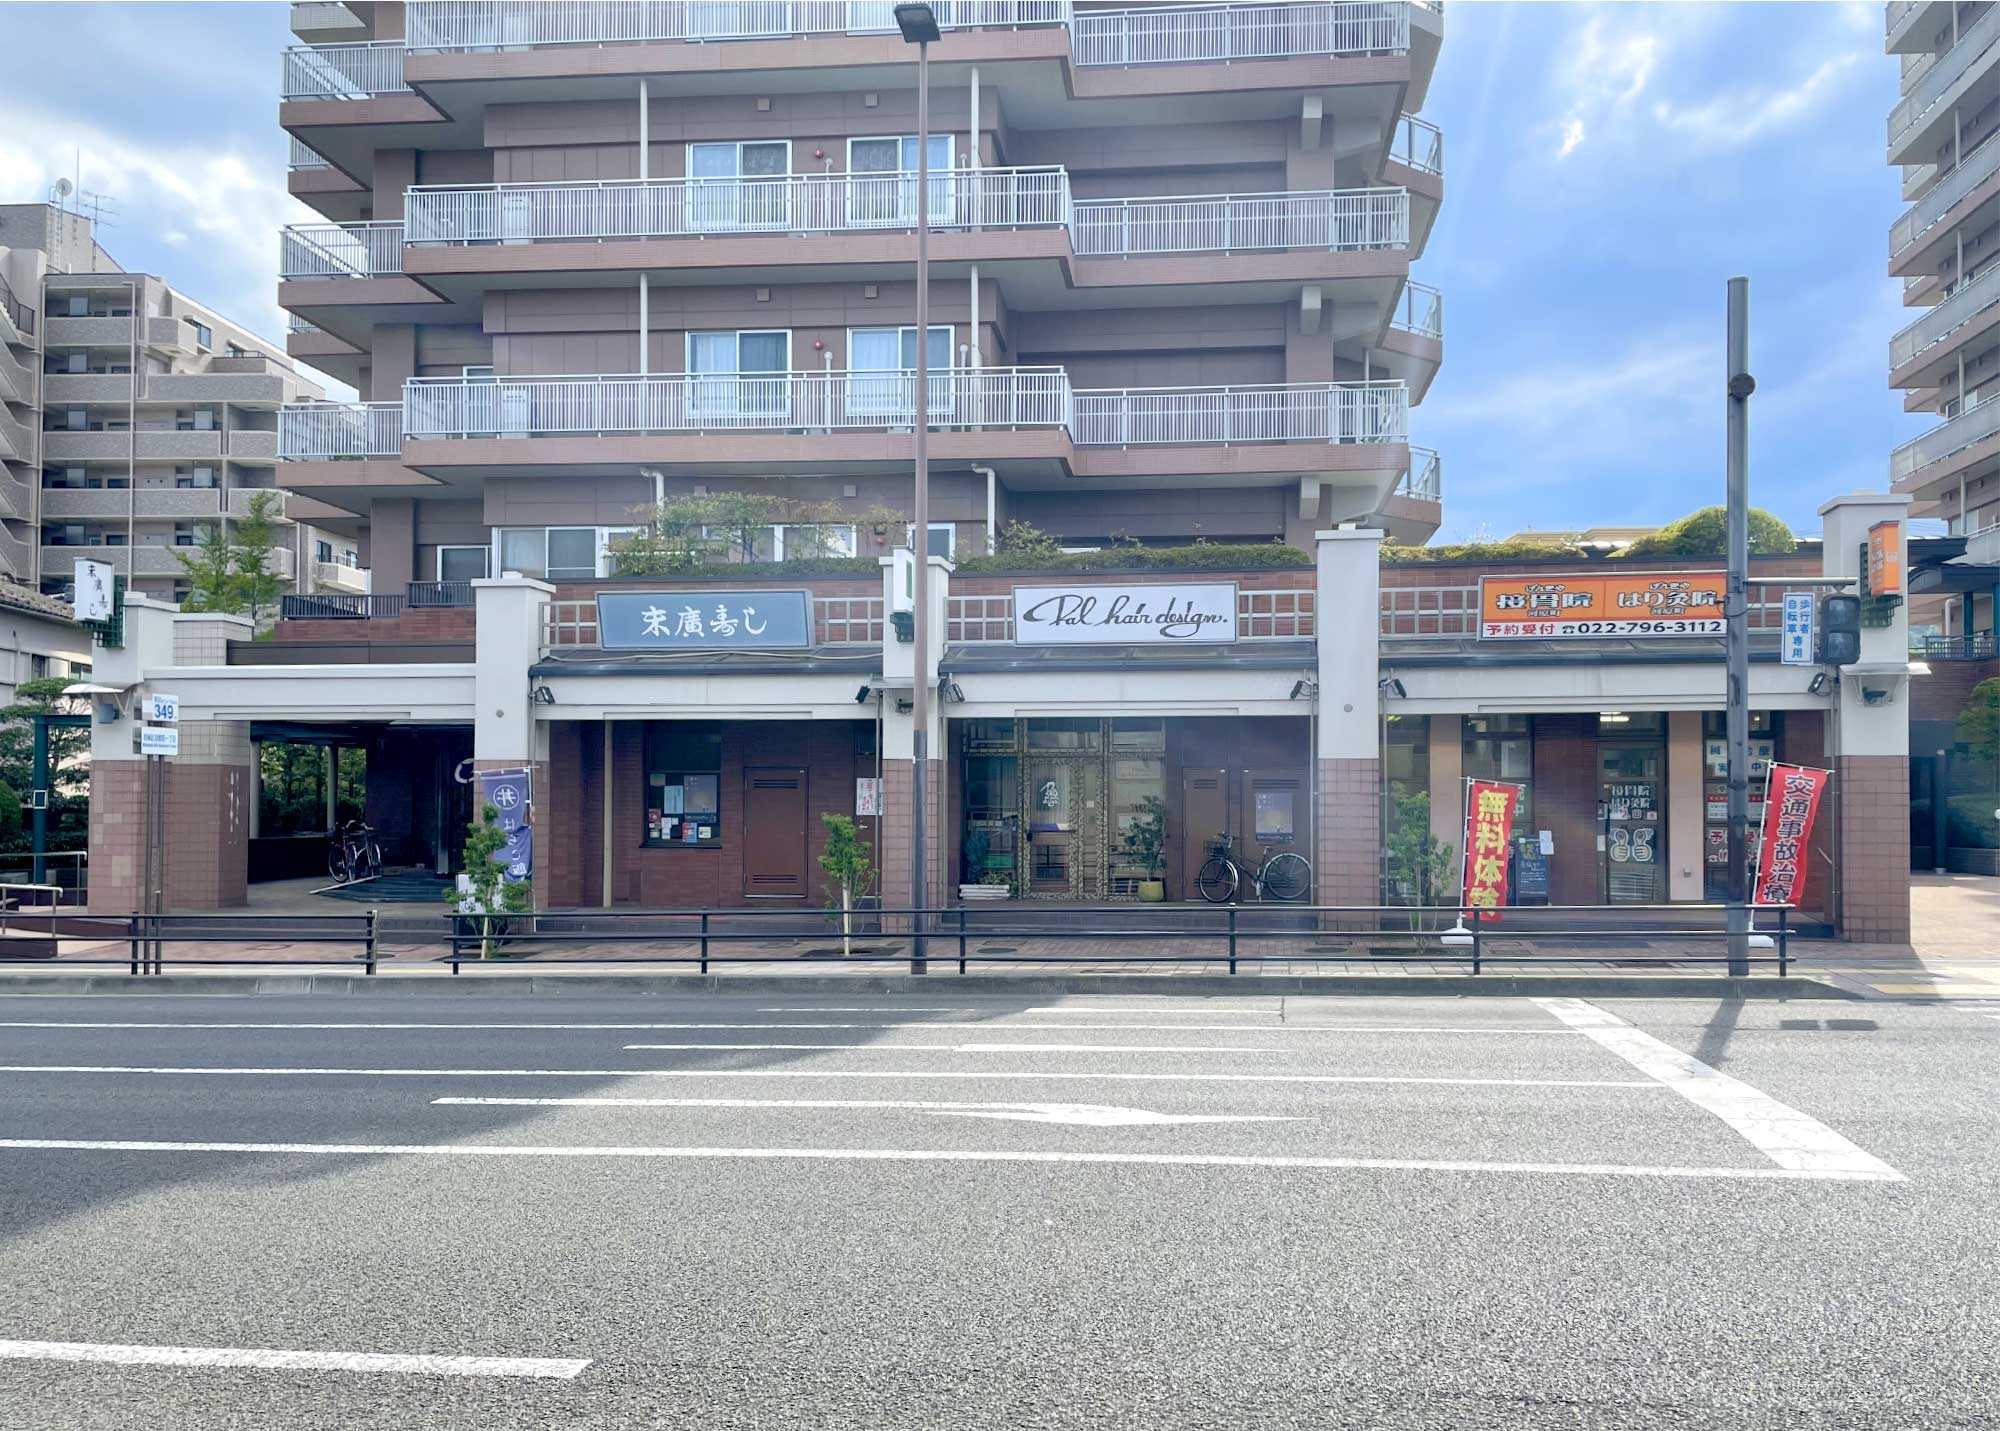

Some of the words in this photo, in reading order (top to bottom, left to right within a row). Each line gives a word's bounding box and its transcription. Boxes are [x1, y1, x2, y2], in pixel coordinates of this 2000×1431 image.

[1023, 595, 1093, 627] Pal
[1095, 595, 1152, 627] hair
[1496, 593, 1592, 609] 接骨院
[1617, 591, 1717, 607] はり灸院
[1486, 623, 1556, 636] 予約受付
[1577, 621, 1722, 635] 022-796-3112
[1787, 600, 1797, 634] 自転車
[1800, 600, 1810, 634] 歩行者
[1793, 636, 1803, 658] 専用
[154, 703, 174, 719] 349
[1470, 790, 1509, 916] 無料体験
[1763, 775, 1815, 904] 交通事故治療
